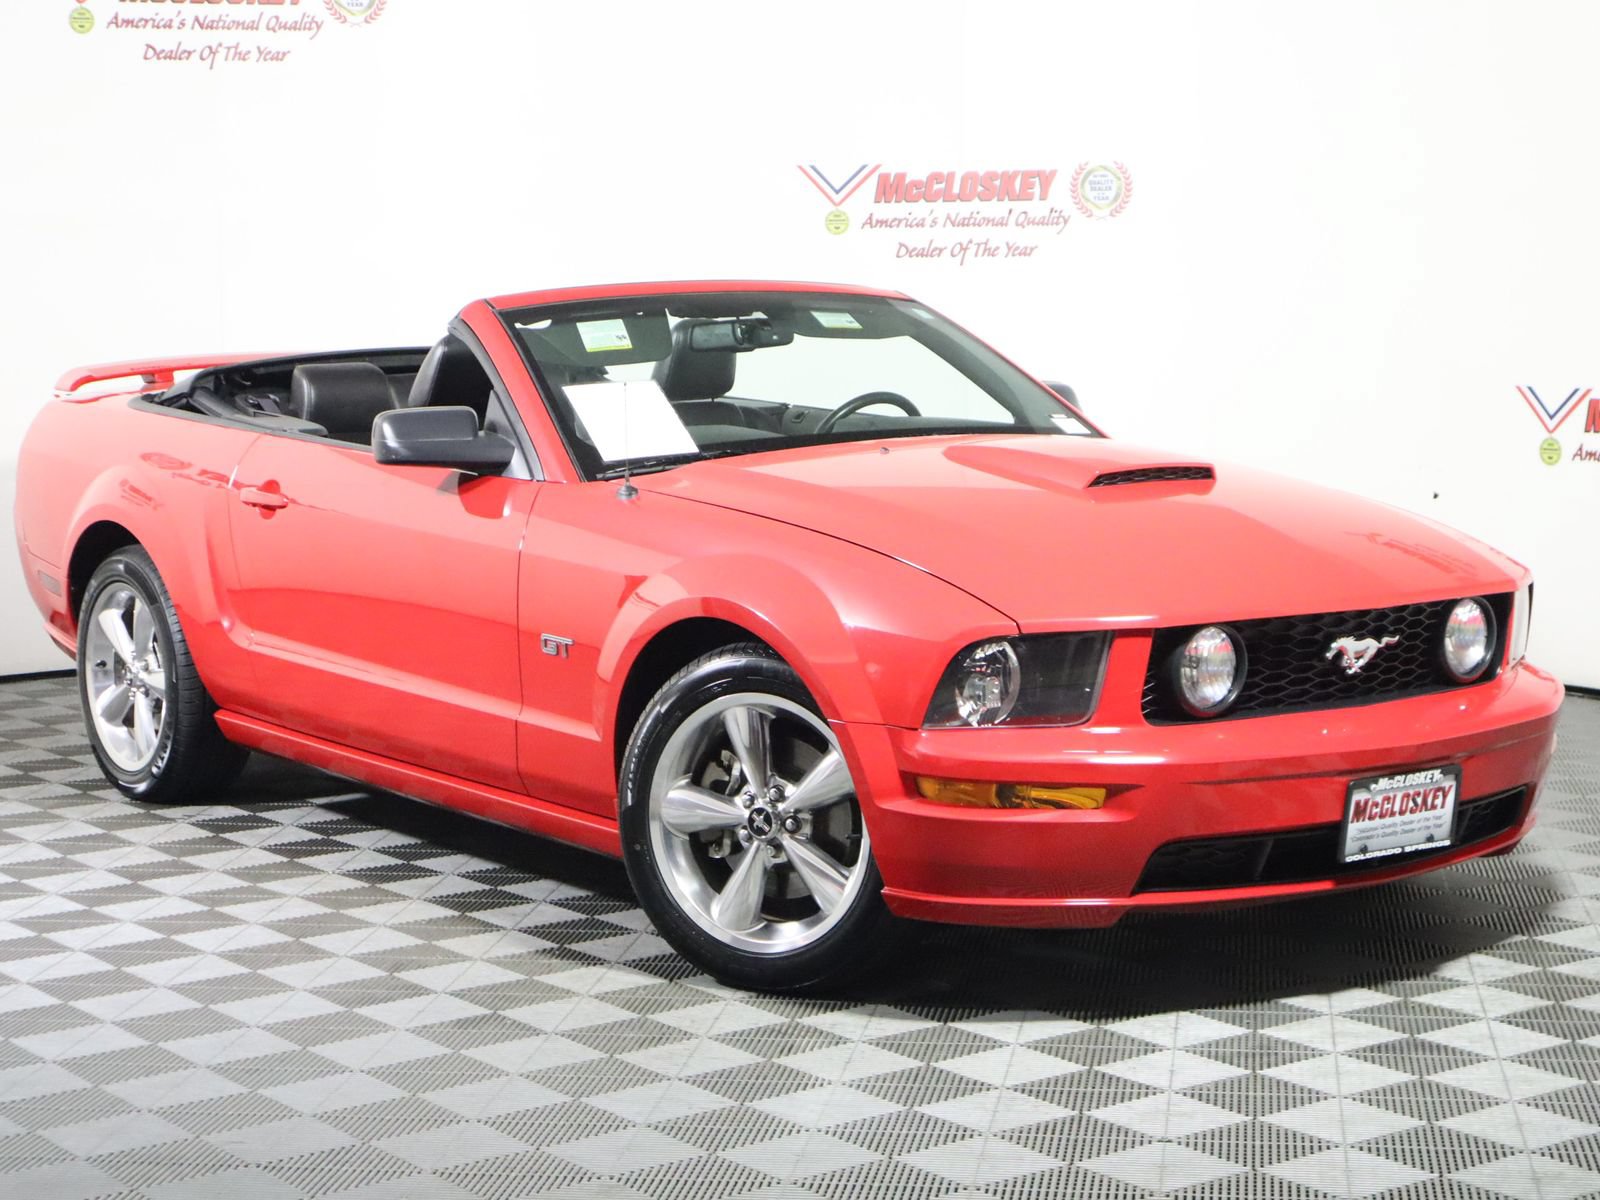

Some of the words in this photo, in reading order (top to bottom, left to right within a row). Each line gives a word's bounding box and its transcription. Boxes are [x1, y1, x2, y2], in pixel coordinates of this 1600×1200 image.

[106, 10, 186, 30] America's
[191, 12, 264, 31] National
[265, 12, 324, 40] Quality
[143, 42, 196, 61] Dealer
[199, 43, 222, 70] Of
[223, 42, 251, 62] The
[256, 45, 291, 62] Year
[874, 169, 1057, 203] McCLOSKEY
[861, 209, 938, 230] America's
[943, 208, 1013, 228] National
[1015, 207, 1071, 234] Quality
[896, 239, 946, 259] Dealer
[950, 238, 973, 266] Of
[974, 238, 1000, 257] The
[1004, 241, 1038, 258] Year
[541, 633, 574, 658] GT
[1350, 784, 1453, 824] McCLOSKEY
[1345, 847, 1402, 862] COLORADO
